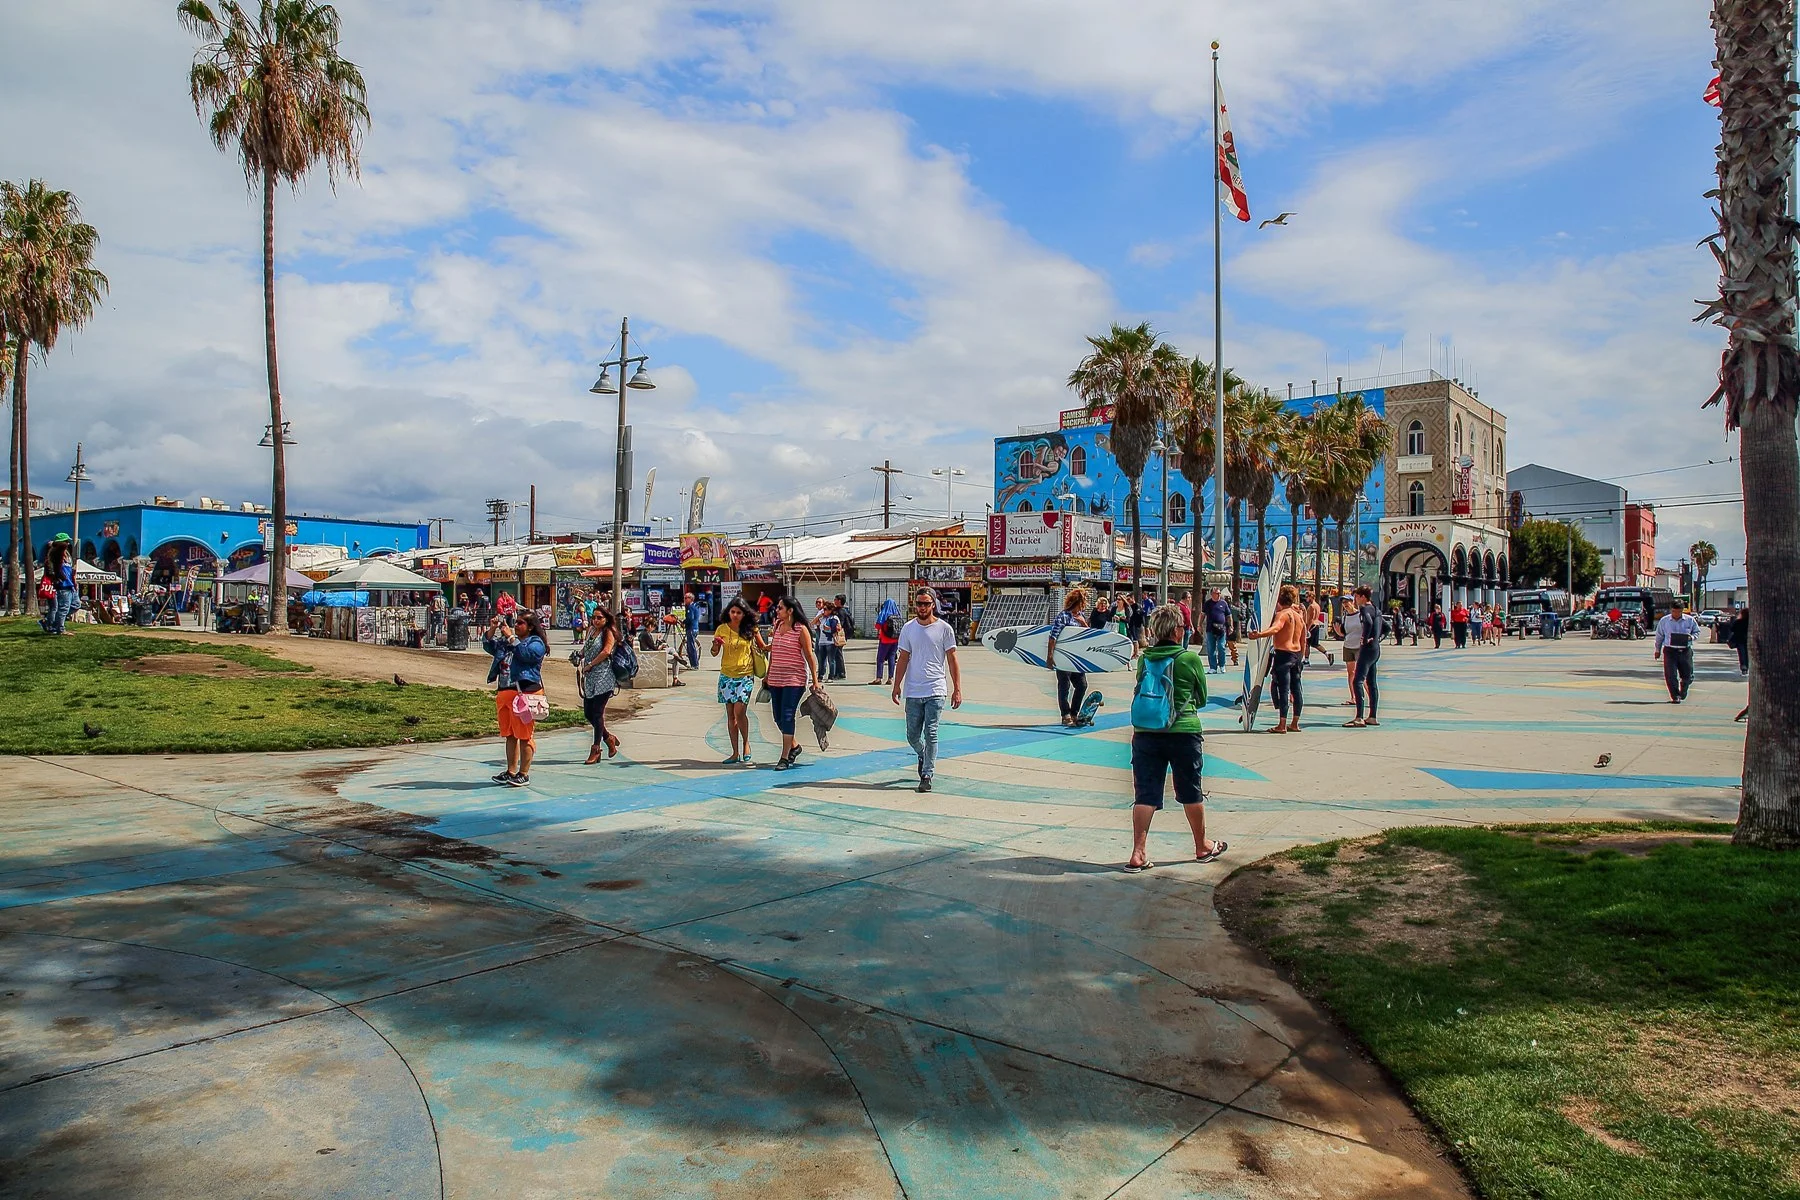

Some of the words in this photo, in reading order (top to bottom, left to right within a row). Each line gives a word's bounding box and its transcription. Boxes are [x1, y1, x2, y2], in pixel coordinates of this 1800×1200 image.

[1009, 526, 1049, 535] Sidewalk
[1391, 523, 1437, 534] DANNY'S
[994, 516, 1002, 553] VENICE
[1076, 532, 1109, 544] Sidewalk
[931, 540, 972, 549] HENNA
[1009, 536, 1041, 545] Market
[733, 549, 765, 558] SEGWAY
[925, 549, 976, 558] TATTOOS
[1076, 543, 1100, 555] Market
